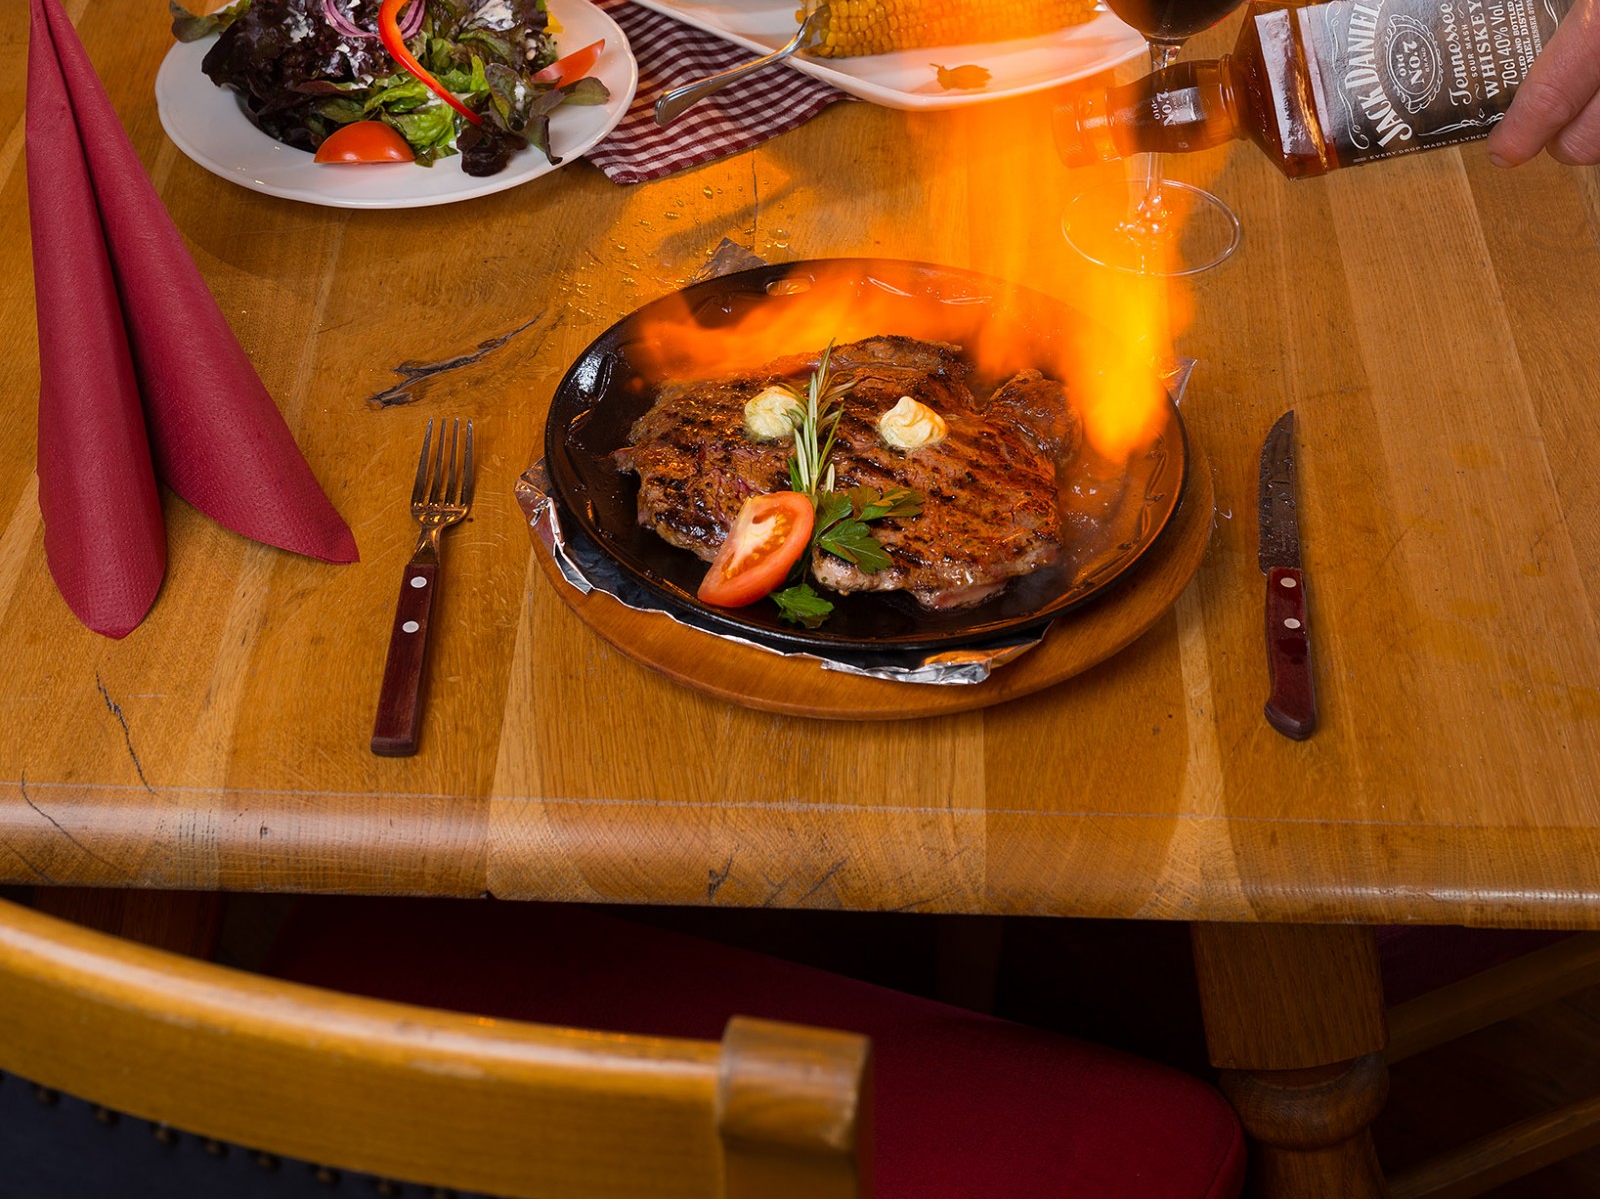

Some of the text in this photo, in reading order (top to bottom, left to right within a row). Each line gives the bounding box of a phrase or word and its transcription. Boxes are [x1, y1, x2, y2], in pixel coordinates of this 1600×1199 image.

[1507, 1, 1520, 37] BOTTLED
[1529, 15, 1543, 59] ENNESSEE
[1421, 46, 1430, 73] BRAND
[1440, 2, 1472, 106] Tennessee
[1461, 24, 1478, 78] SOUR MASH
[1467, 0, 1500, 99] WHISKEY
[1488, 1, 1519, 88] 70cl 40% Vol.
[1514, 37, 1525, 54] AND
[1357, 85, 1413, 148] JACK
[1369, 150, 1398, 160] EVERY
[1398, 146, 1421, 154] DROP
[1423, 140, 1447, 149] MADE
